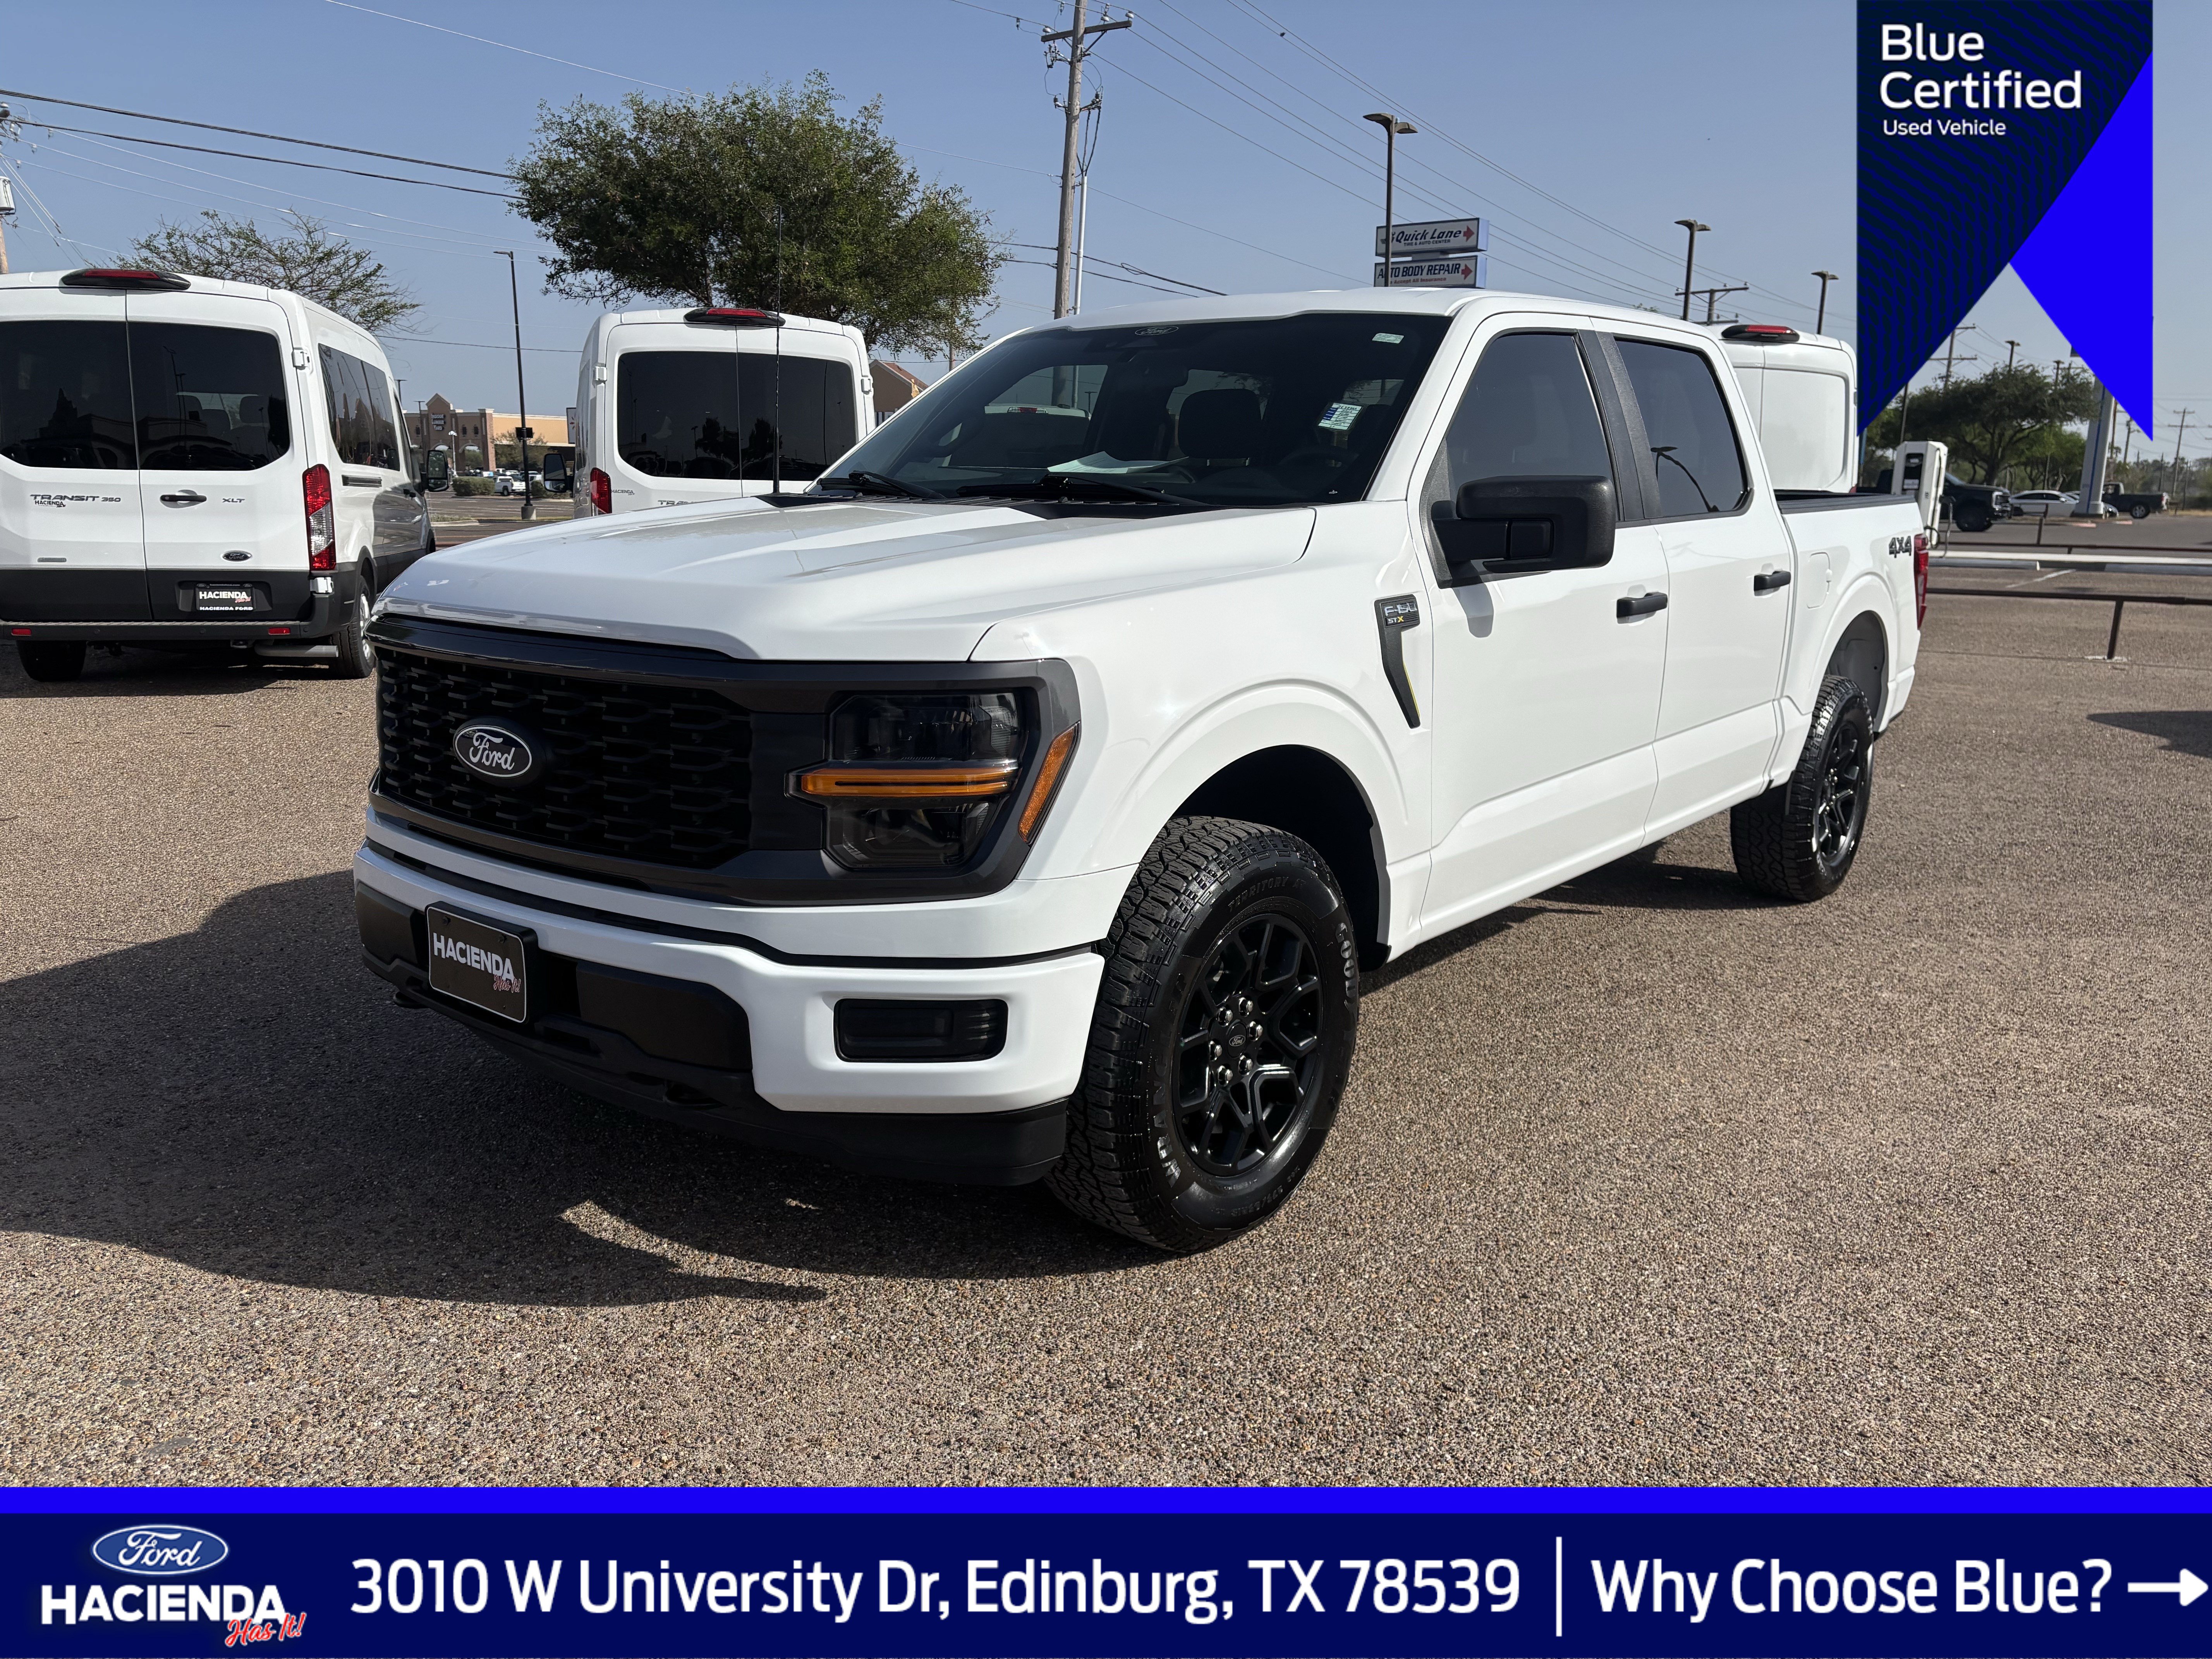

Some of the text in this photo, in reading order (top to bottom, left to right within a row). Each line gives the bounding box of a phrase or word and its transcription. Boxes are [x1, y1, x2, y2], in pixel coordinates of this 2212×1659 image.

[1396, 229, 1462, 243] Quick Lane
[1377, 263, 1461, 279] ATO BODY REPAIR
[199, 591, 248, 599] HACIENDA
[1384, 603, 1417, 616] F-150
[1388, 615, 1405, 624] STX
[469, 732, 515, 771] Ford
[433, 932, 514, 984] HACIENDA
